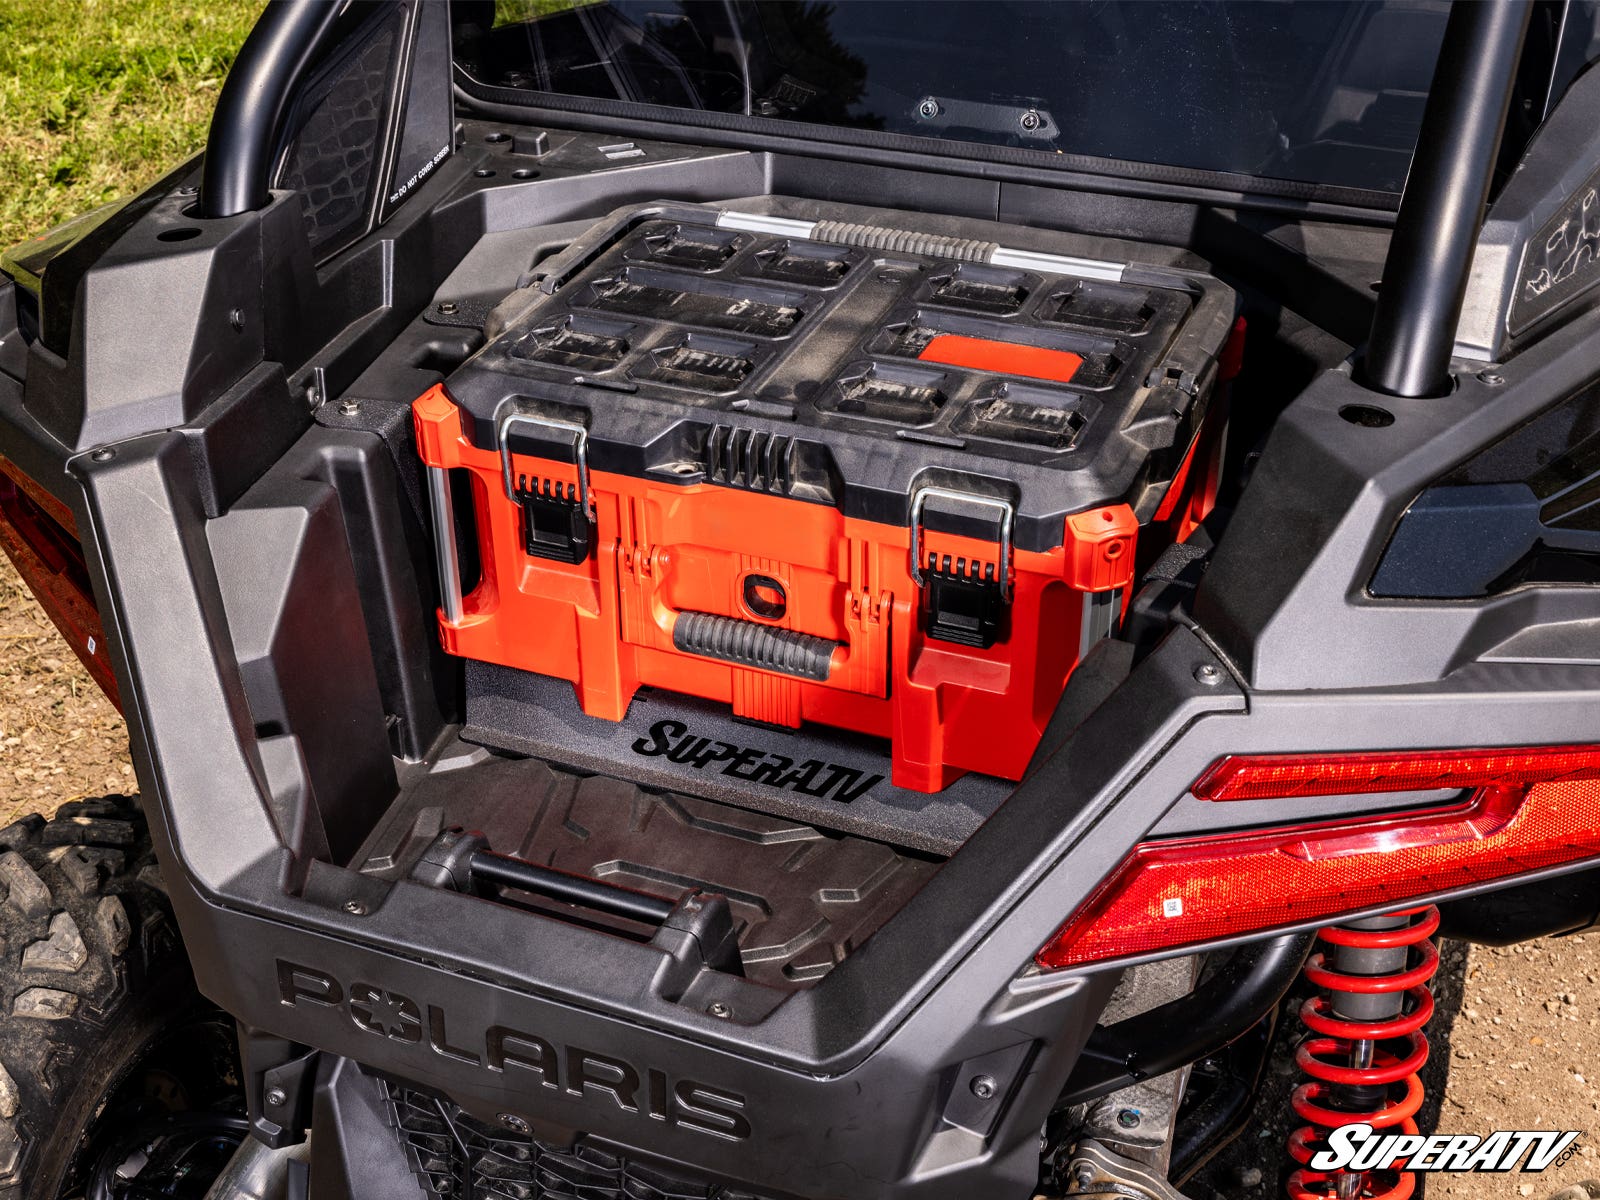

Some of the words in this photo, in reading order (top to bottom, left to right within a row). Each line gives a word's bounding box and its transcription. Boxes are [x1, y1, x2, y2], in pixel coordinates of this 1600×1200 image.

[398, 185, 407, 197] DO
[407, 174, 418, 189] NOT
[418, 160, 434, 179] COVER
[433, 144, 450, 165] SCREEN
[631, 719, 886, 804] SUPERATV
[275, 957, 752, 1143] POLARIS
